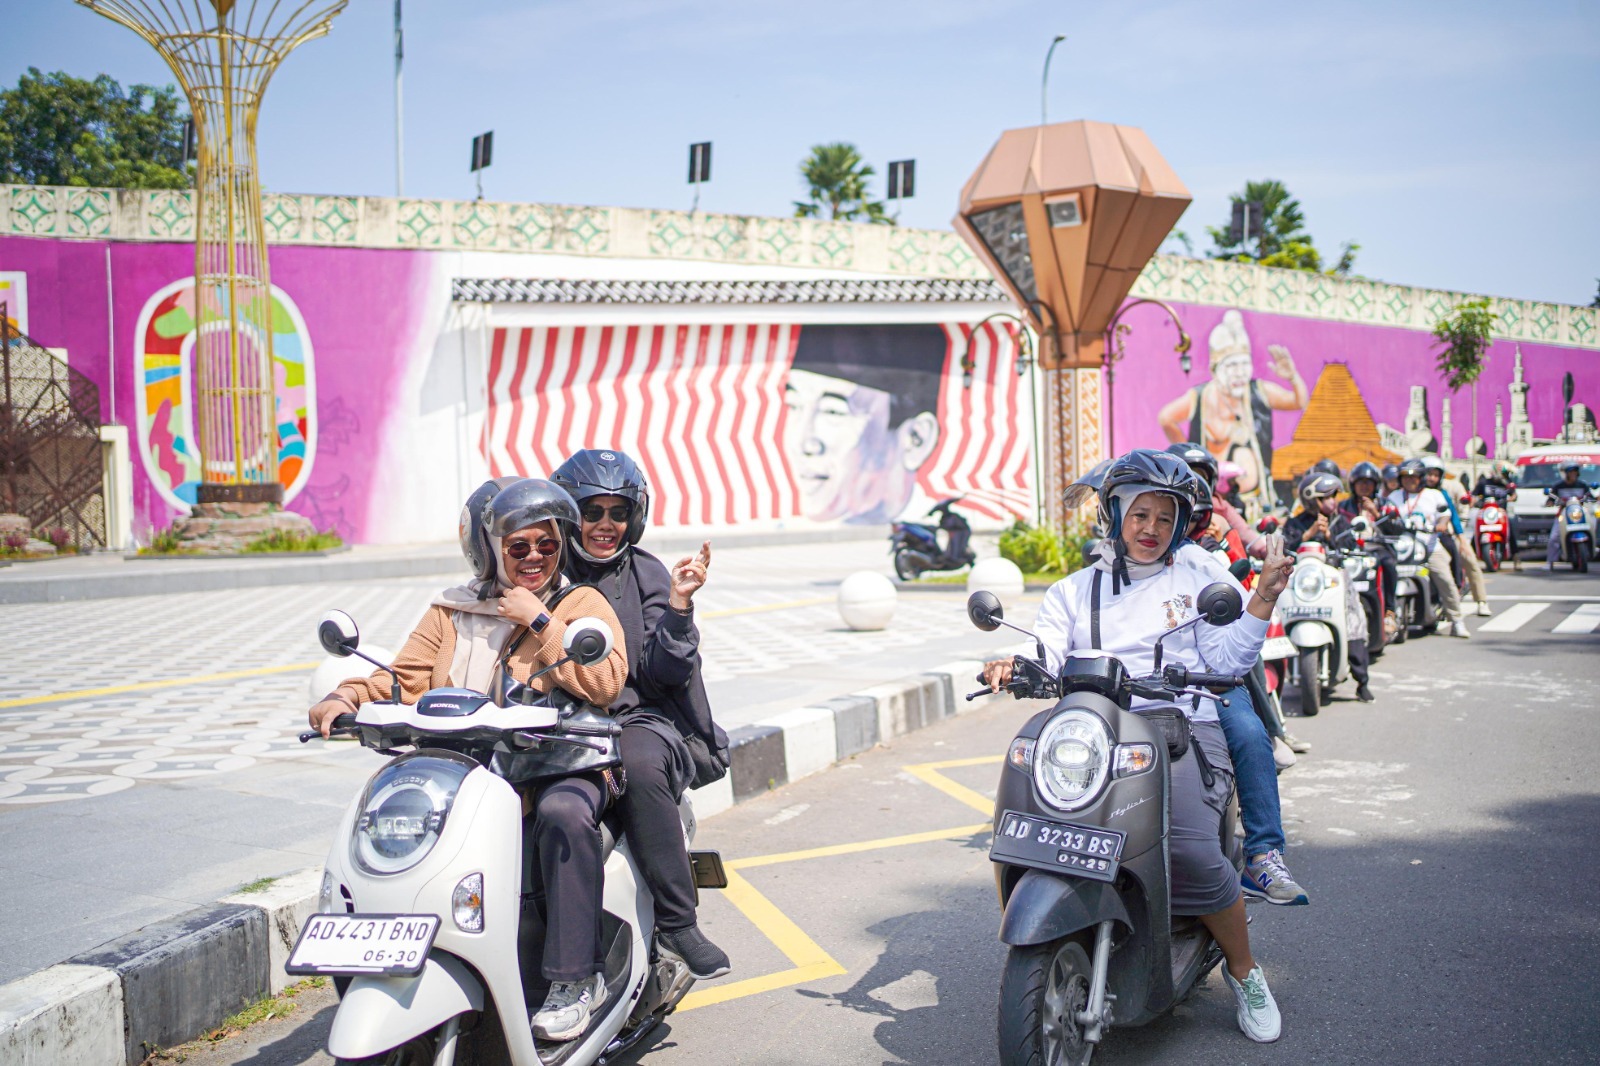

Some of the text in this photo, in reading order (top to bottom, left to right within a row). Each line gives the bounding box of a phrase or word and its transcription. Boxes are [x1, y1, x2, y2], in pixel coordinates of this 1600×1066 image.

[429, 702, 461, 710] HONDA
[1005, 819, 1113, 856] AD 3233 BS
[1257, 870, 1275, 890] N
